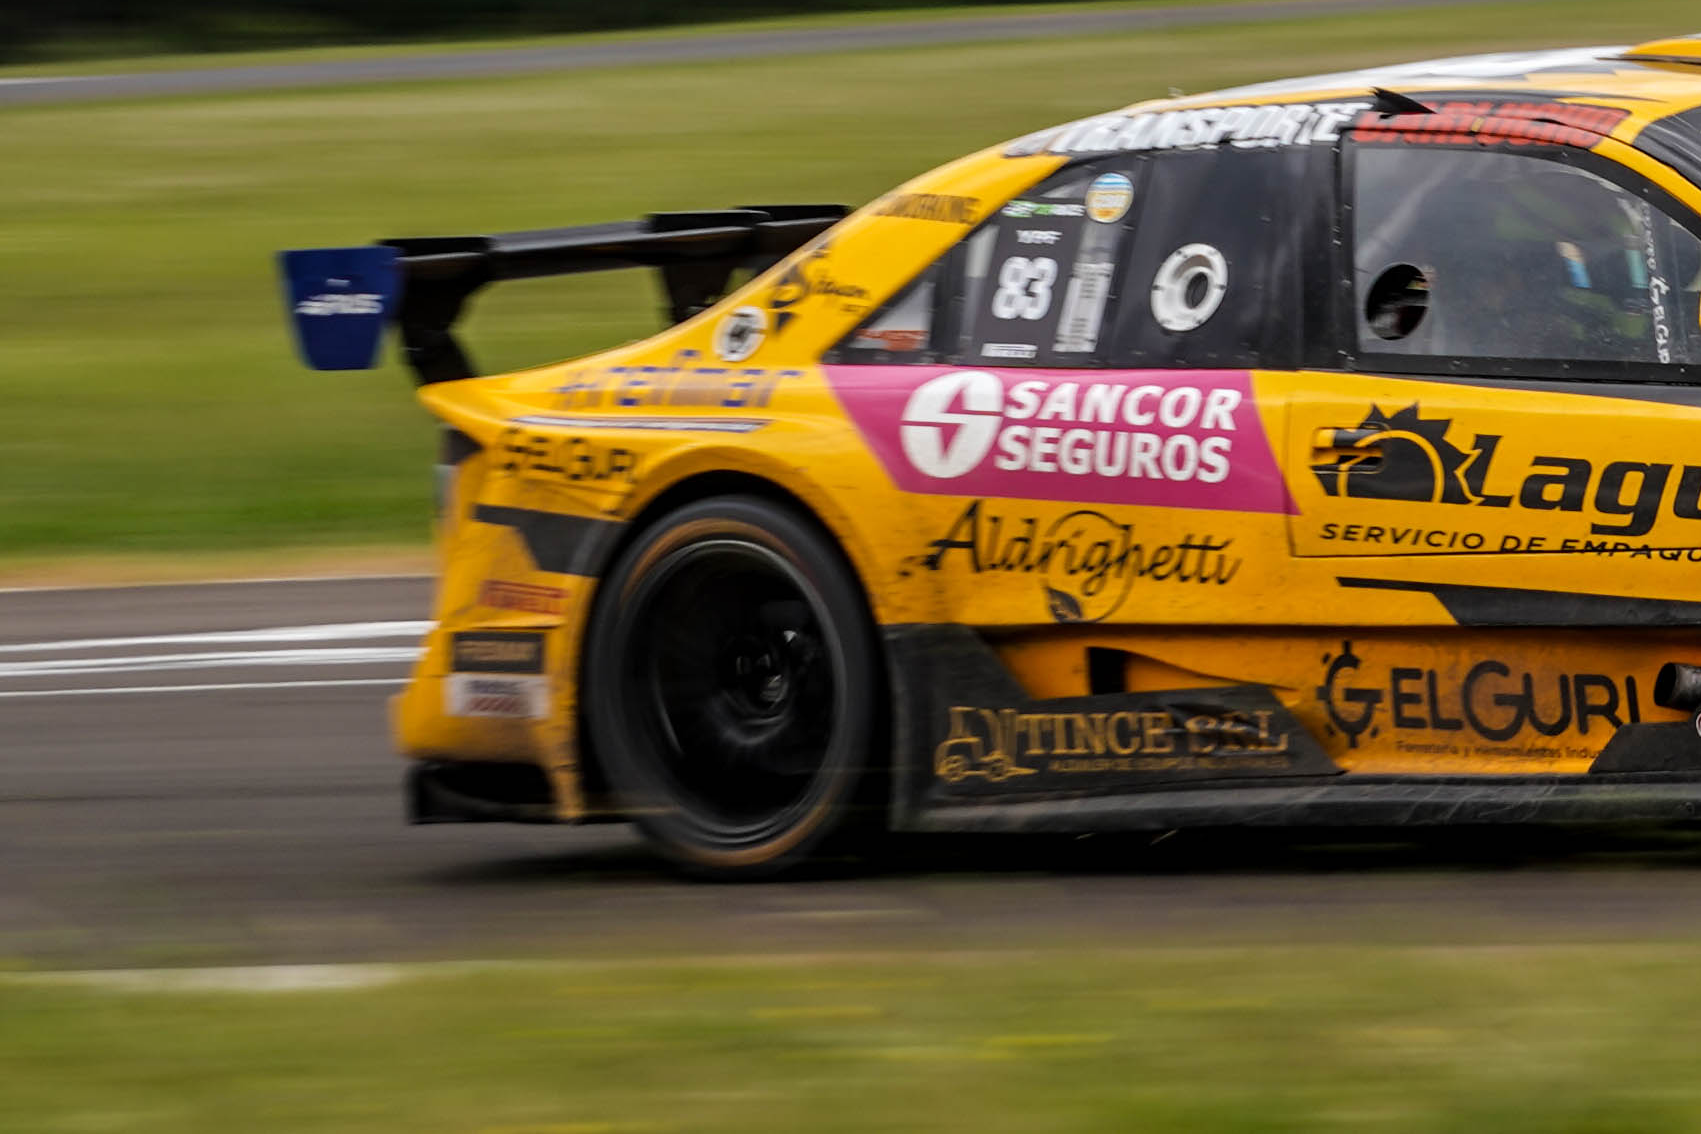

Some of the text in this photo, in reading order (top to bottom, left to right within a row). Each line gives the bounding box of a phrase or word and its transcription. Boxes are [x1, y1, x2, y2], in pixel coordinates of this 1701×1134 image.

[992, 256, 1058, 320] 83
[1002, 379, 1242, 431] SANCOR
[994, 424, 1233, 484] SEGUROS
[898, 498, 1243, 596] Aldrighetti
[1319, 522, 1486, 550] SERVICIO
[1501, 535, 1546, 554] DE
[1316, 640, 1640, 748] GELGURI
[1015, 710, 1176, 755] TINCE
